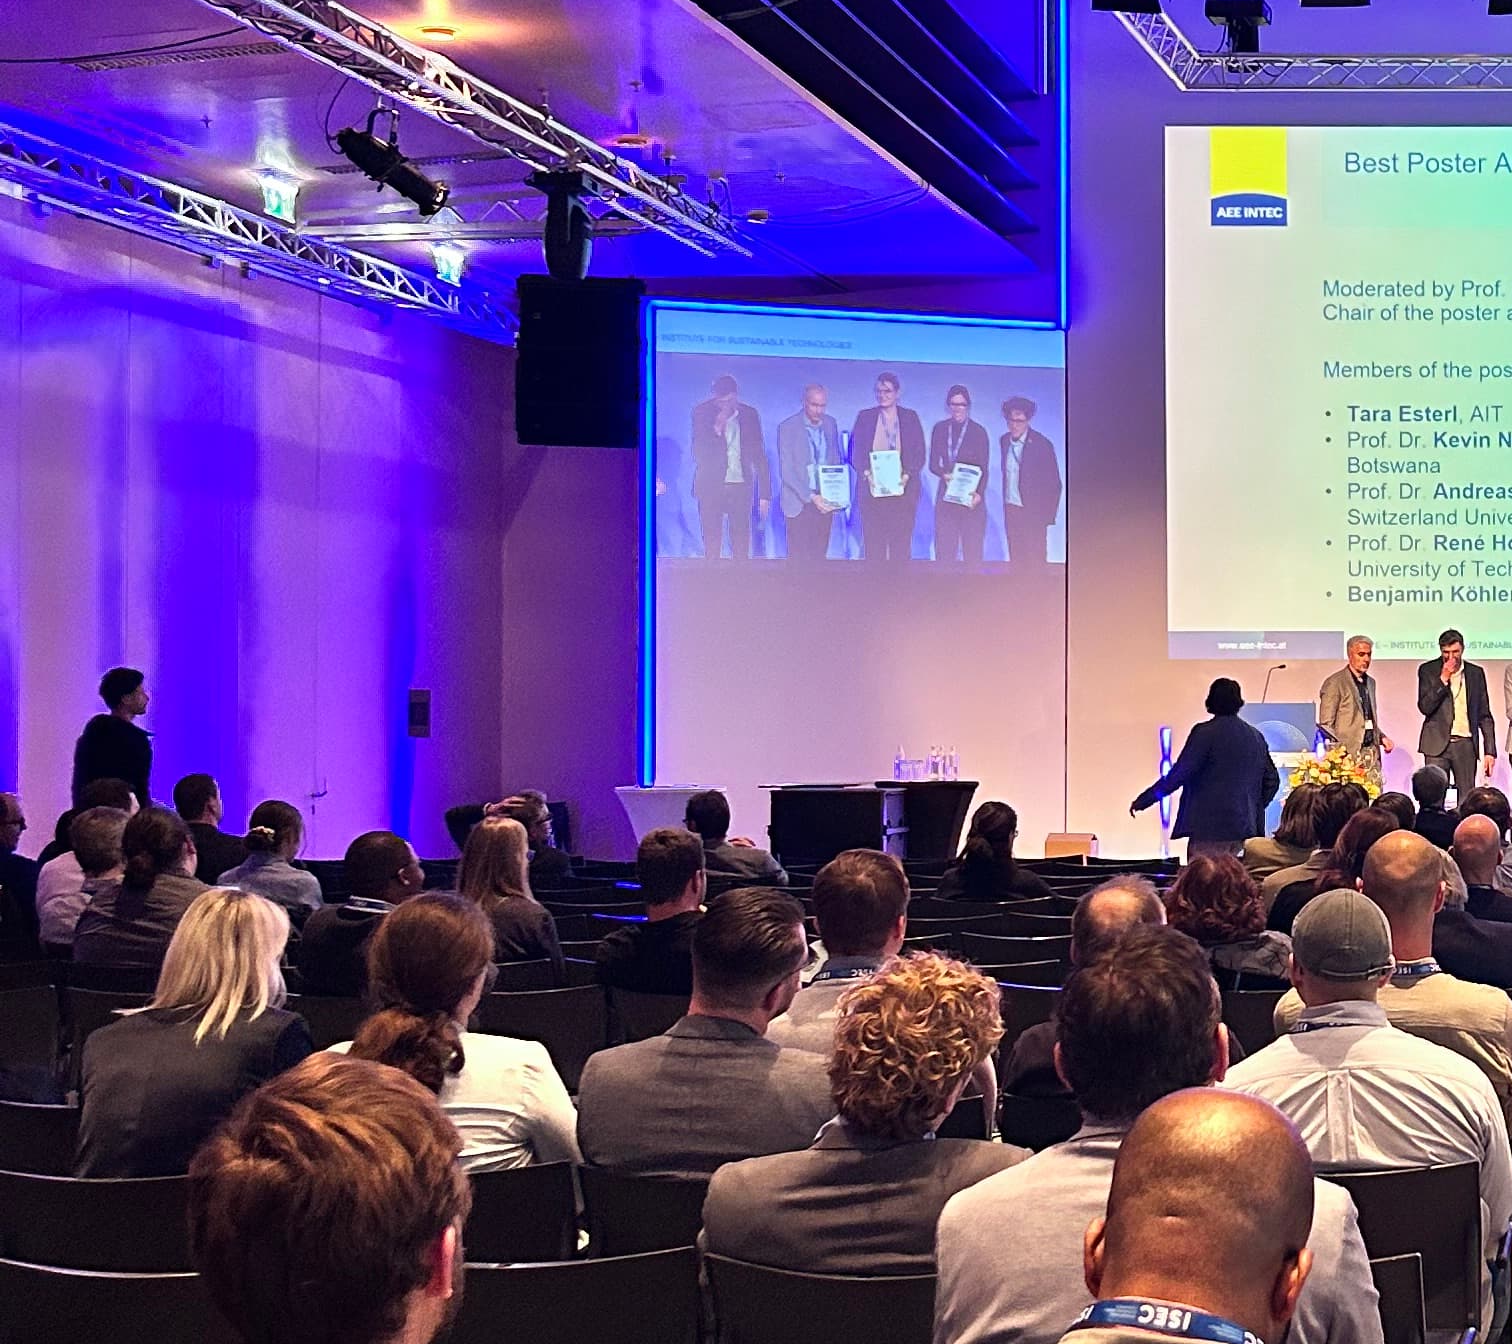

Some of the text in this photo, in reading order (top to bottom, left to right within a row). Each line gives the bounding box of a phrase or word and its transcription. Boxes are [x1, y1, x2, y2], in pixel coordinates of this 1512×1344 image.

[1345, 152, 1399, 173] Best
[1408, 152, 1486, 173] Poster
[1216, 206, 1283, 219] AEE INTEC
[1323, 280, 1424, 297] Moderated
[1433, 280, 1454, 303] by
[1323, 304, 1374, 321] Chair
[1381, 304, 1400, 321] of
[1405, 305, 1434, 321] the
[1441, 305, 1500, 325] poster
[1324, 361, 1412, 378] Members
[1419, 361, 1438, 378] of
[1443, 361, 1472, 378] the
[1347, 406, 1503, 425] Tara Esterl, AIT
[1434, 432, 1490, 449] Kevin
[1348, 457, 1440, 474] Botswana
[1348, 509, 1458, 526] Switzerland
[1434, 534, 1485, 552] René
[1348, 561, 1441, 582] University
[1448, 560, 1465, 578] of
[1348, 586, 1443, 608] Benjamin
[1137, 1304, 1192, 1332] ISEC
